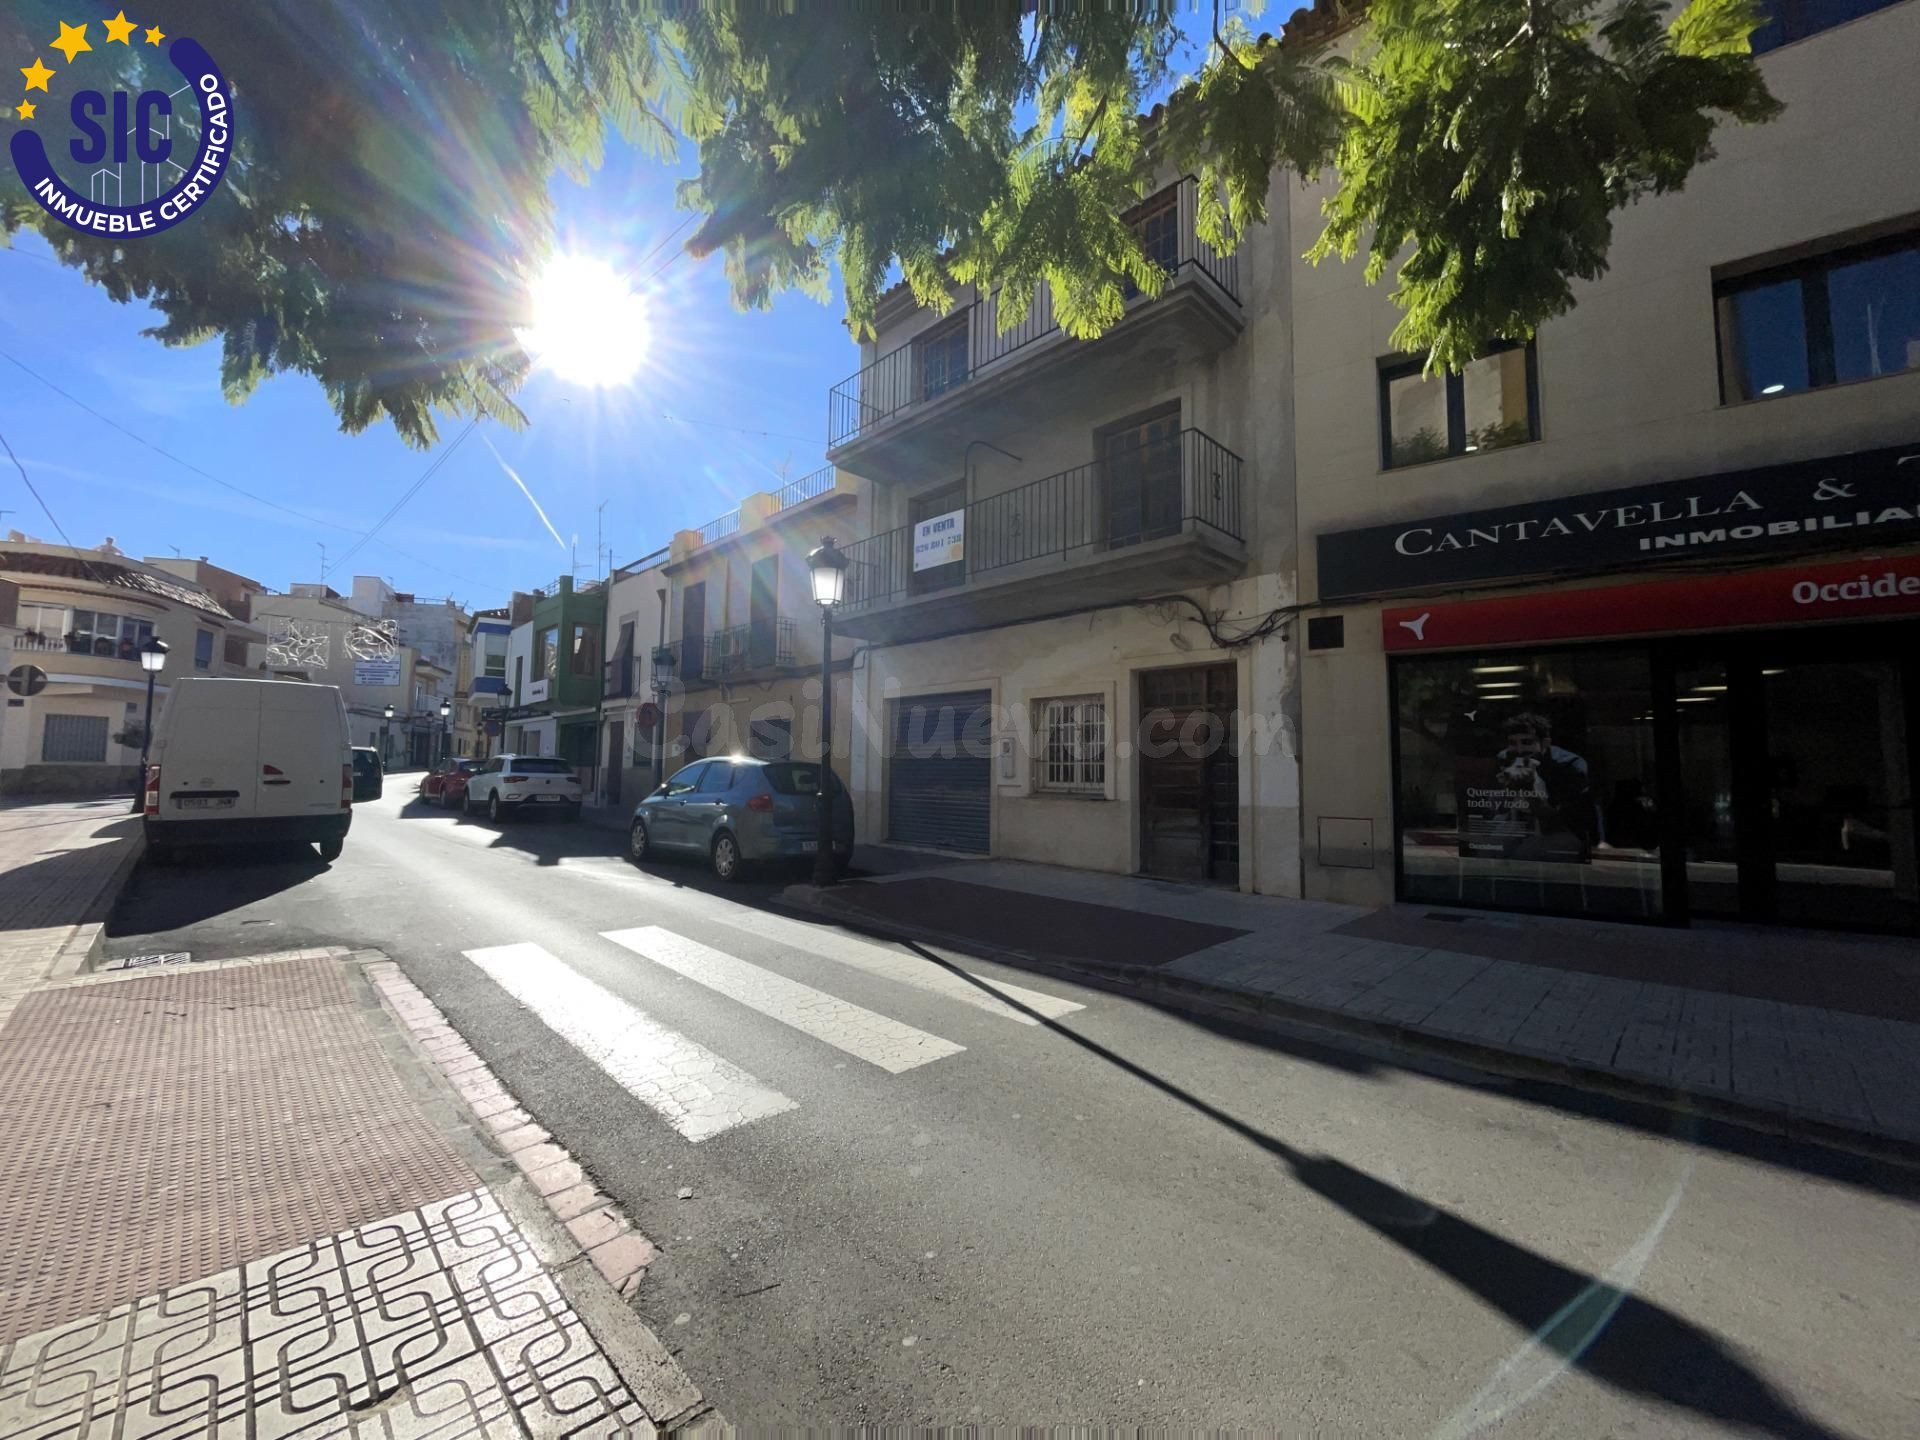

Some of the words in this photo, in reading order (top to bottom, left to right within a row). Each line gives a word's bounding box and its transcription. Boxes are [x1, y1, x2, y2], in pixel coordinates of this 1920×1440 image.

[932, 517, 955, 533] VENTA
[1394, 490, 1764, 556] CANTAVELLA
[1813, 478, 1857, 501] &
[1639, 504, 1920, 550] INMOBILIA
[1791, 572, 1920, 604] Occide
[1466, 787, 1517, 798] Quererlo
[1467, 799, 1492, 808] todo
[1494, 800, 1502, 810] y
[1503, 800, 1530, 809] todo
